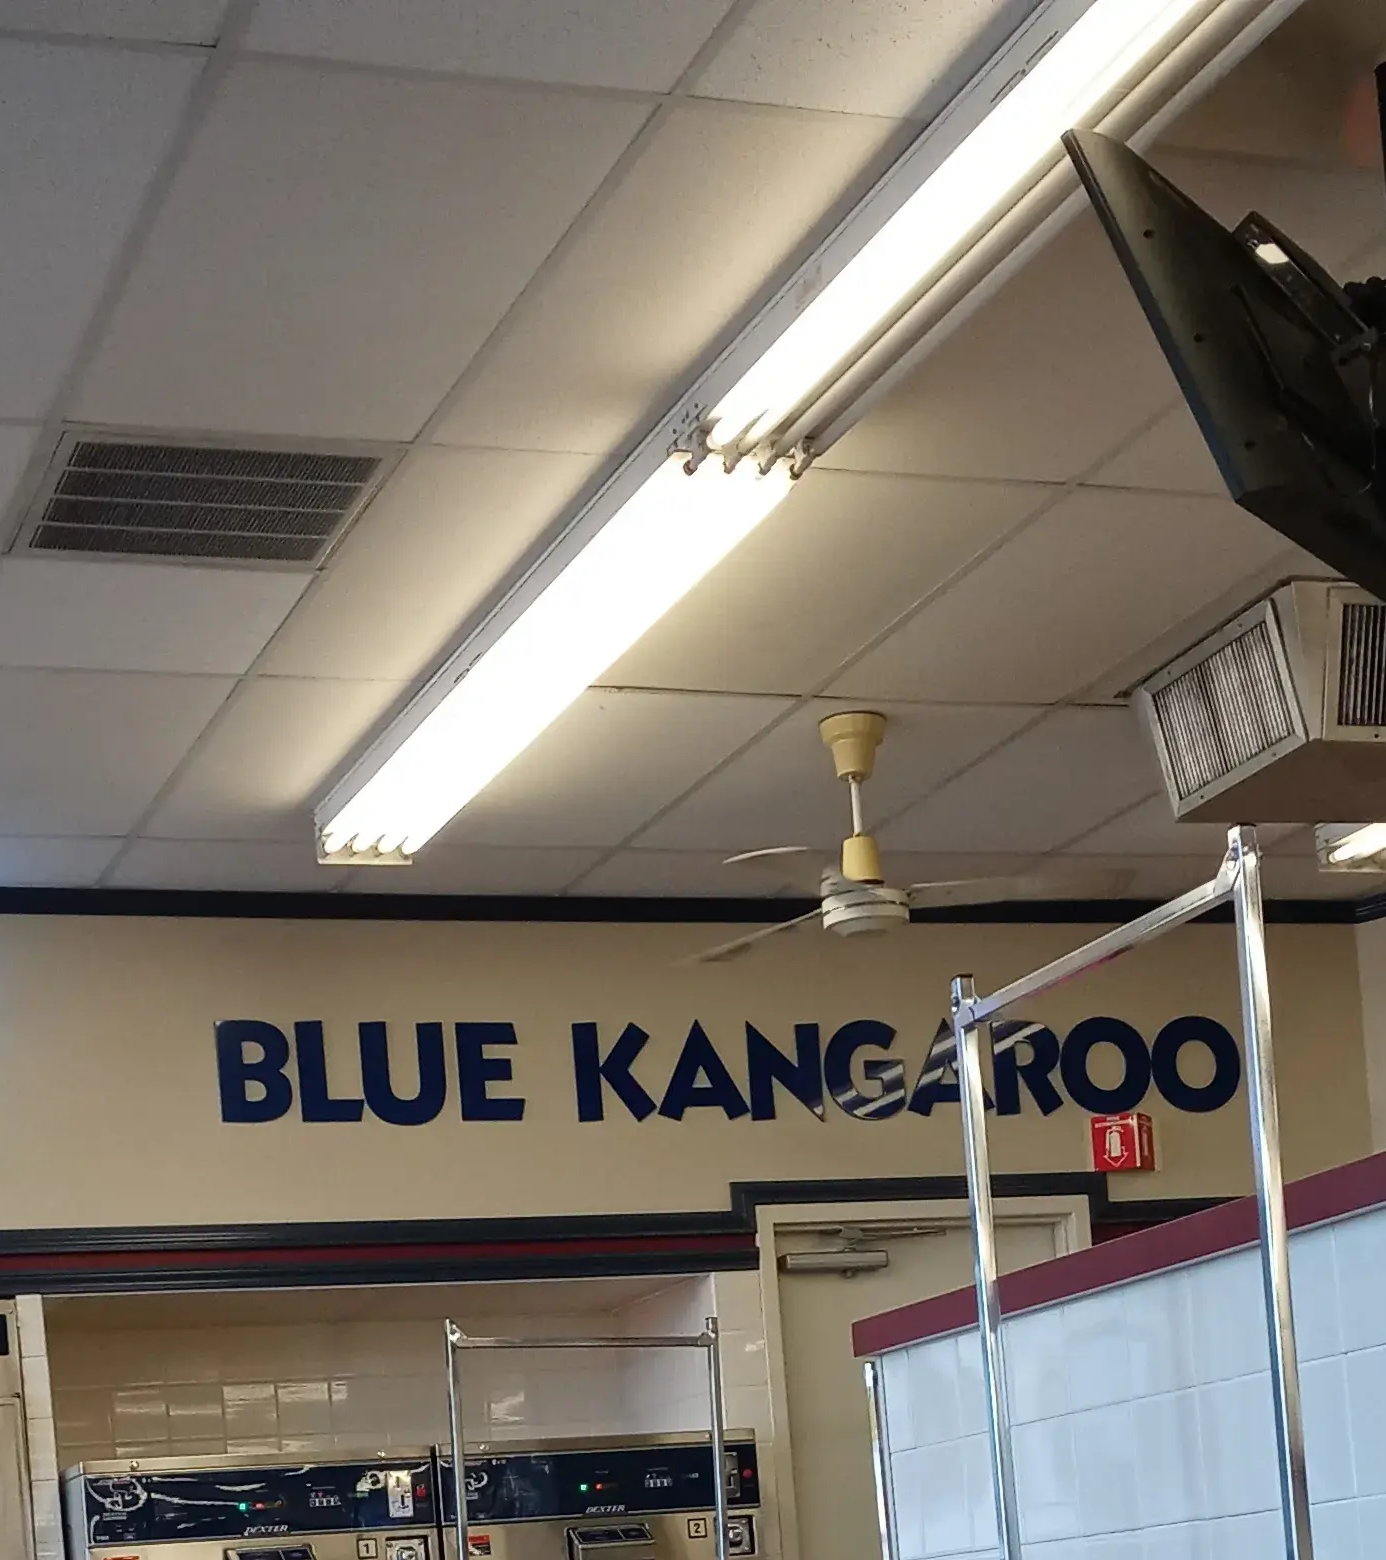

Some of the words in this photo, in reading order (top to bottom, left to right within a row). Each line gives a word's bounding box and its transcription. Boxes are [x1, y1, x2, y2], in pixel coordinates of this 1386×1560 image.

[214, 1019, 526, 1126] BLUE
[570, 1015, 1241, 1123] KANGAROO
[693, 1522, 702, 1534] 2
[363, 1543, 370, 1554] 1
